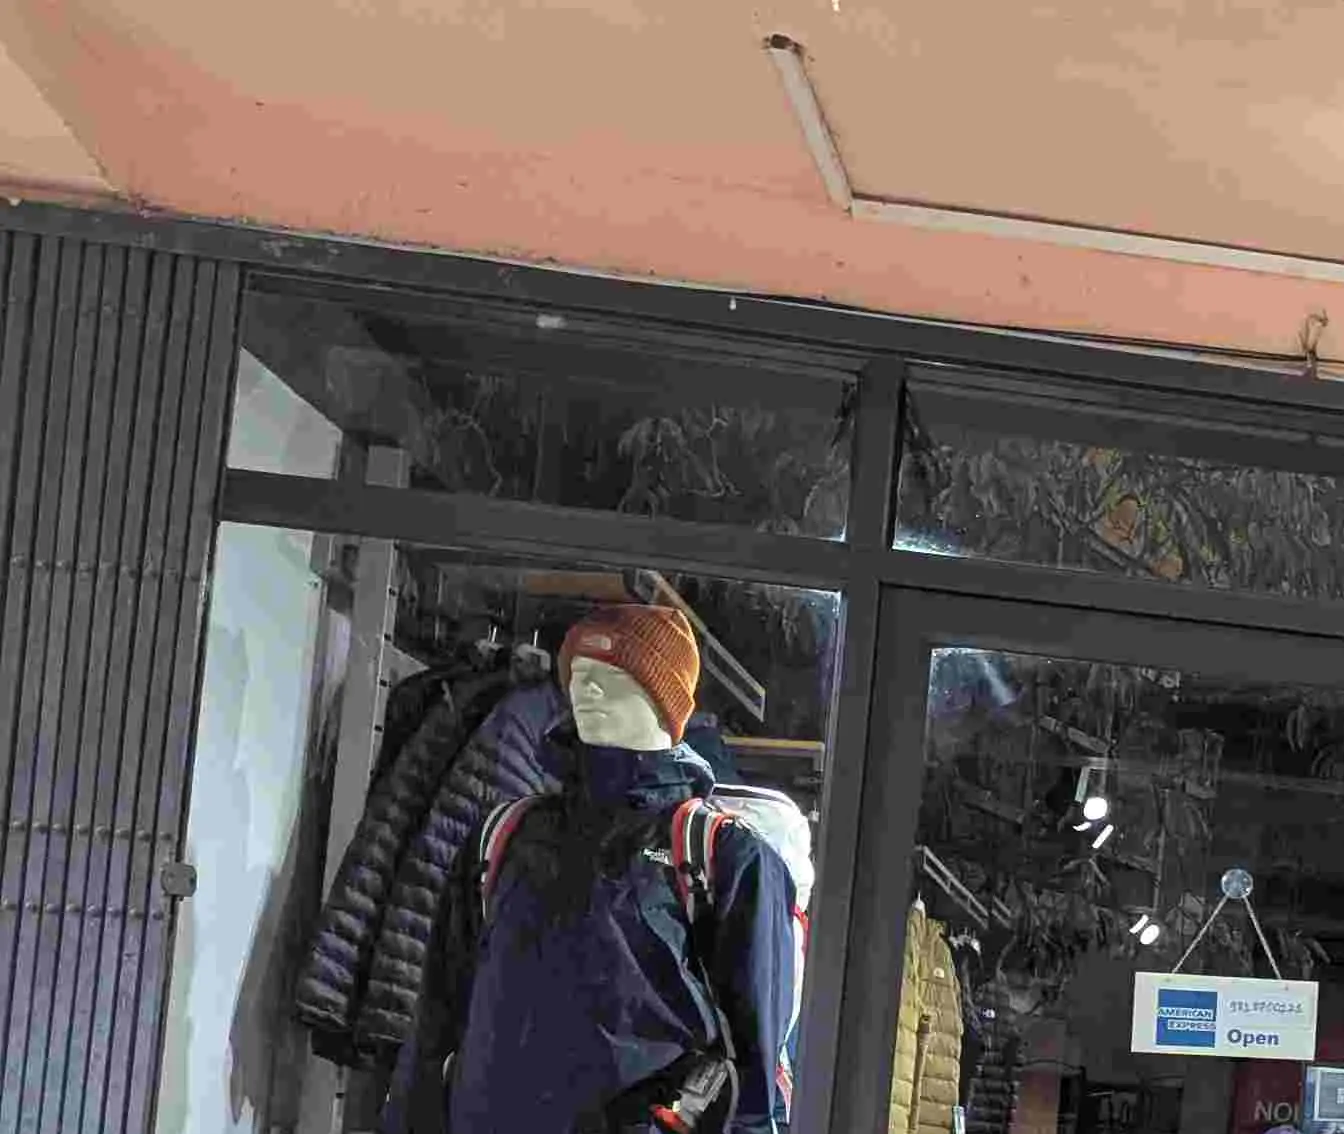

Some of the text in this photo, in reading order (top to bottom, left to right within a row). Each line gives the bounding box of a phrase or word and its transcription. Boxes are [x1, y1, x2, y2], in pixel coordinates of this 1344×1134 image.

[1158, 1007, 1213, 1019] AMERICAN
[1168, 1020, 1217, 1031] EXPRESS
[1227, 1028, 1280, 1048] Open
